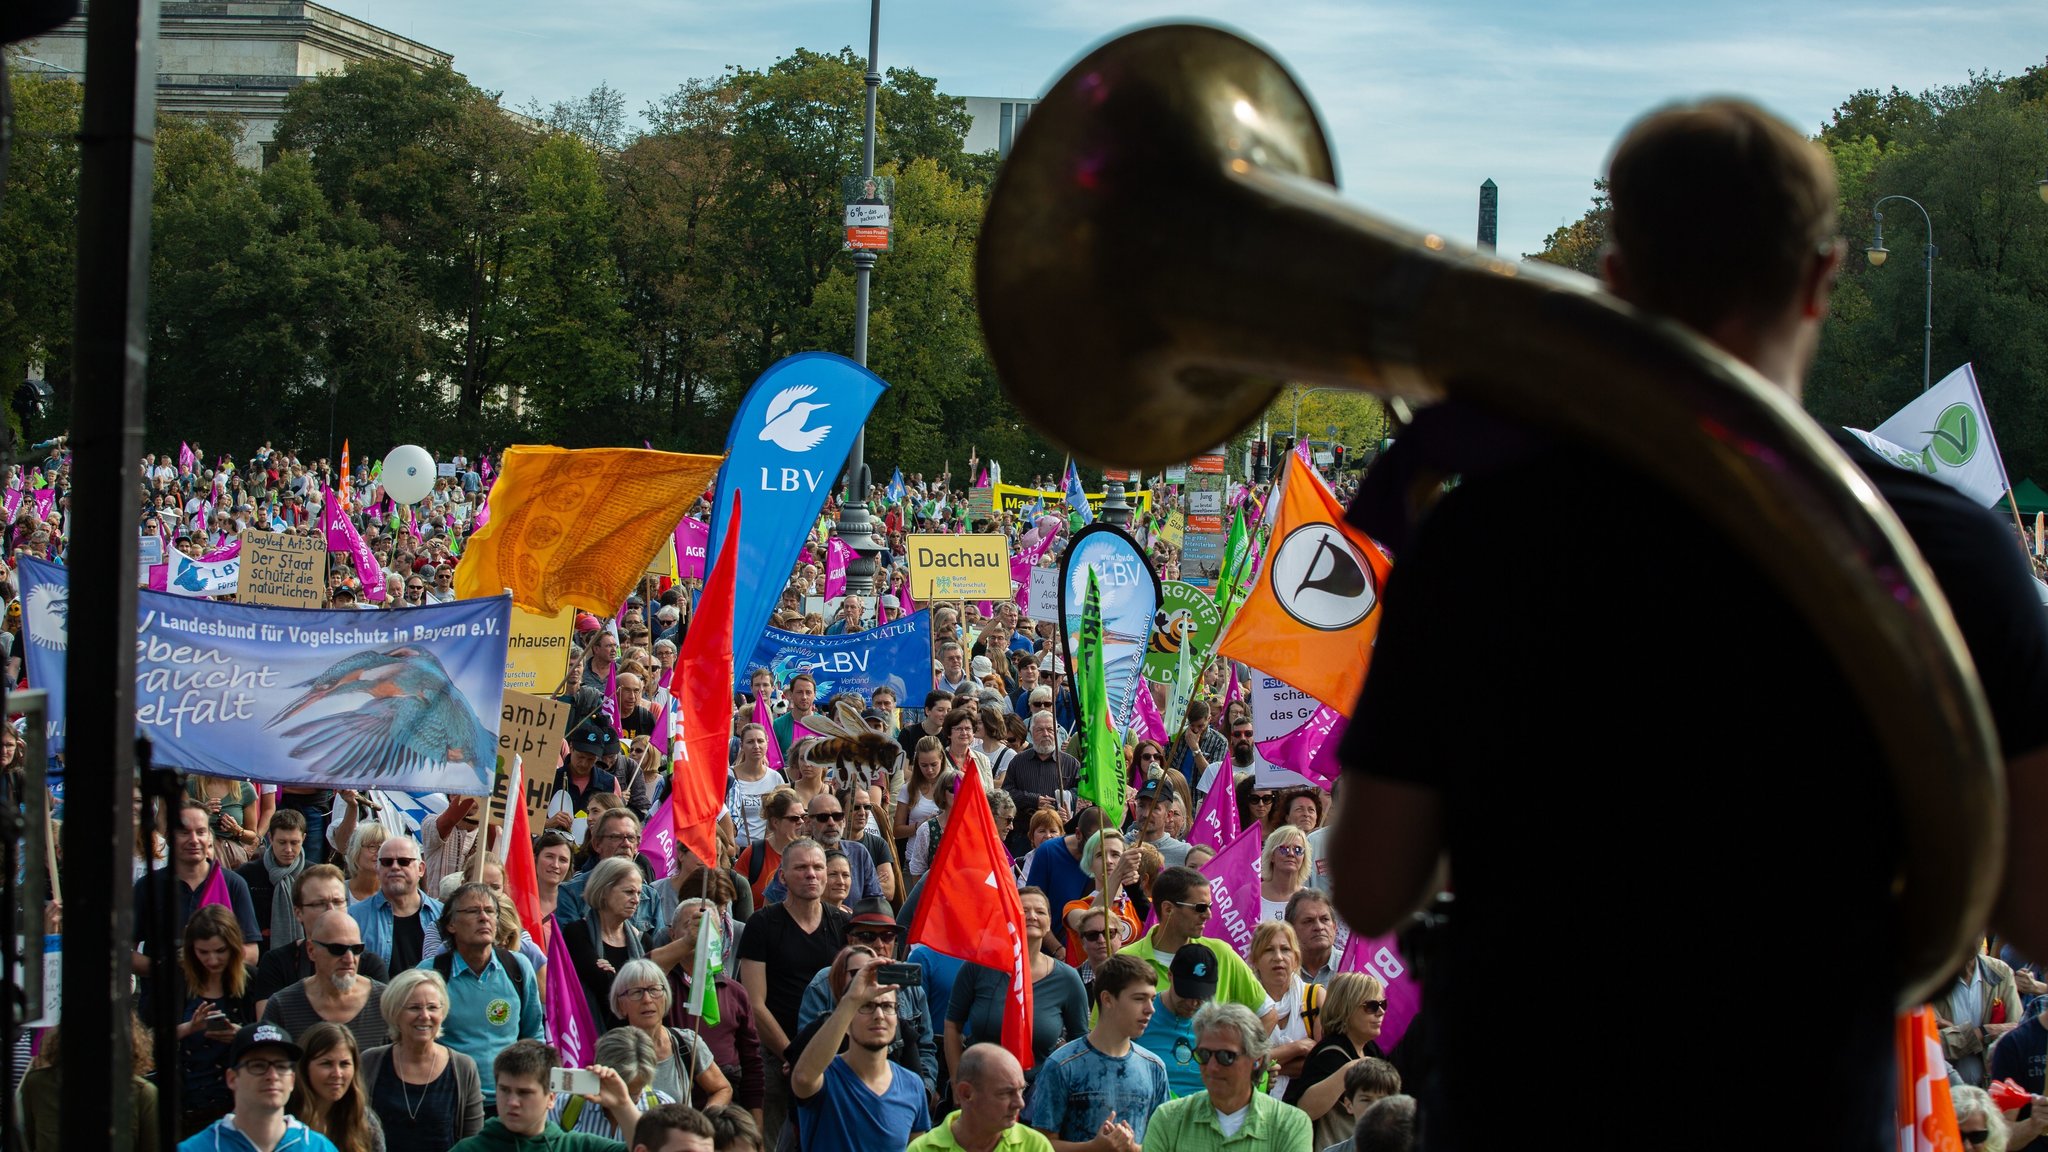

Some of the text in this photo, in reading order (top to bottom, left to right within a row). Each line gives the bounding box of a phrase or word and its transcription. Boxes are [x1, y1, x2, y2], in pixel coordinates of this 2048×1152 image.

[850, 206, 863, 217] 6%
[860, 215, 877, 223] packen
[760, 467, 824, 493] LBV
[1200, 492, 1213, 502] Jung
[251, 550, 314, 571] Der Staat
[918, 548, 1000, 568] Dachau
[1100, 553, 1135, 562] www.lbv.de
[251, 567, 313, 584] schützt die
[1102, 563, 1141, 586] LBV
[217, 581, 239, 590] Fürst
[249, 581, 318, 600] natürlichen
[160, 612, 256, 640] Landesbund
[260, 624, 284, 642] für
[288, 625, 389, 648] Vogelschutz
[393, 628, 408, 643] in
[413, 624, 466, 642] Bayern
[470, 617, 500, 637] e.V.
[865, 621, 916, 641] NATUR
[508, 633, 566, 648] nhausen
[818, 650, 870, 673] LBV
[841, 676, 870, 685] Verband
[1263, 679, 1282, 688] CSU
[1114, 672, 1134, 726] Vogelschutz
[502, 702, 558, 730] ambi
[1270, 710, 1293, 720] das
